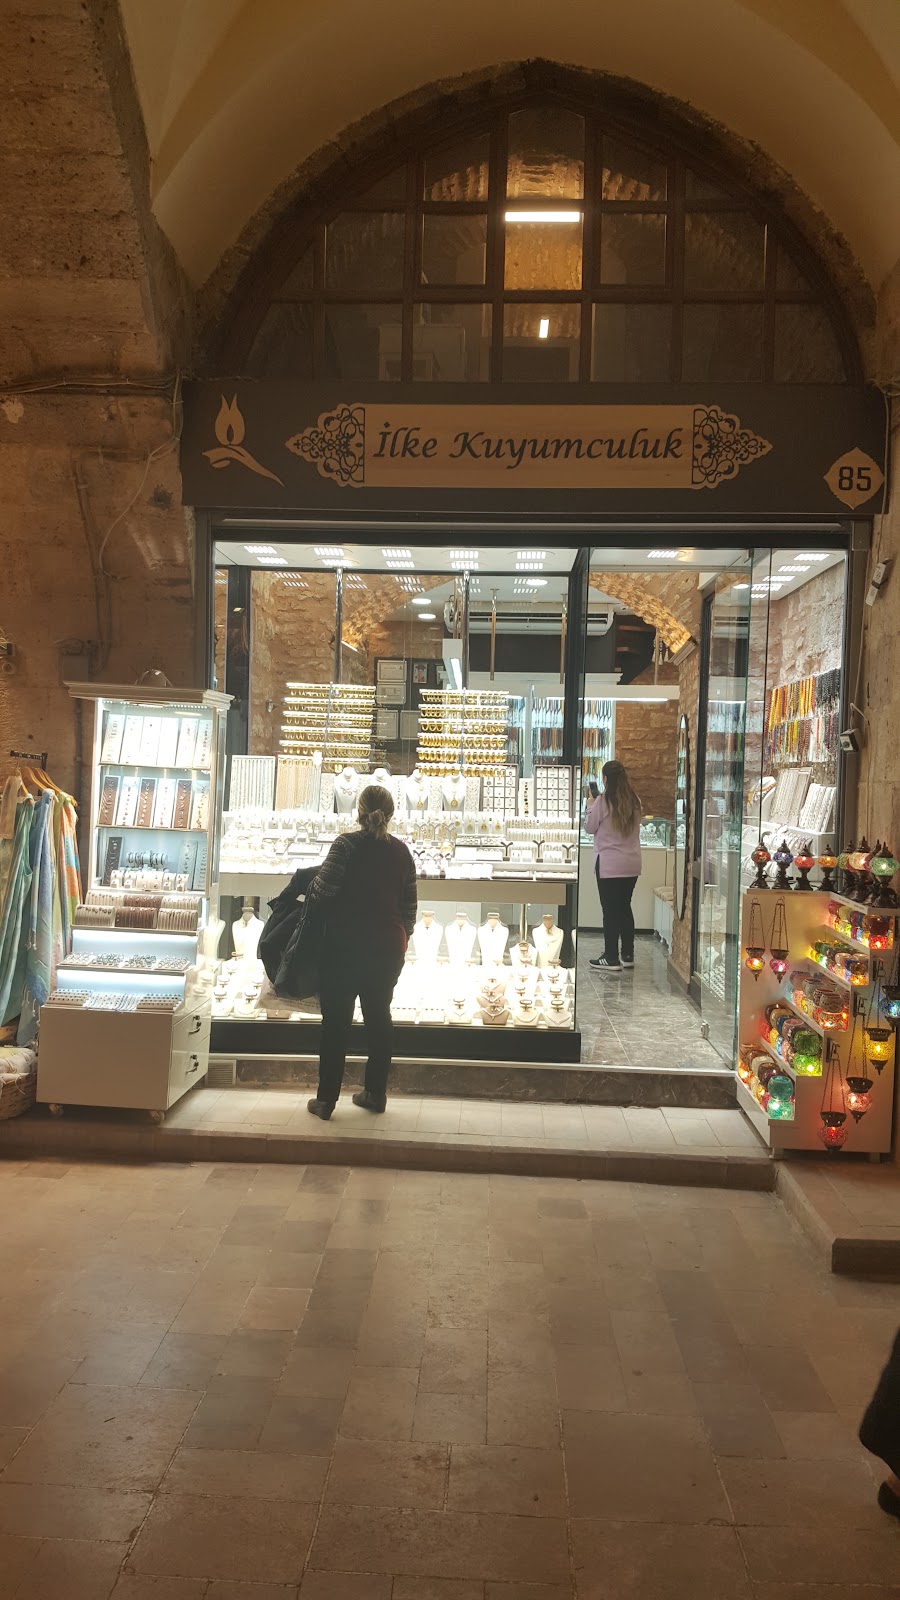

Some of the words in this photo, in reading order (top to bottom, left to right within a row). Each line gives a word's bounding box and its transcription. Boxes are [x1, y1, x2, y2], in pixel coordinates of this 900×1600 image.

[372, 421, 438, 459] İlke
[448, 427, 684, 470] Kuyumculuk
[838, 465, 872, 492] 85
